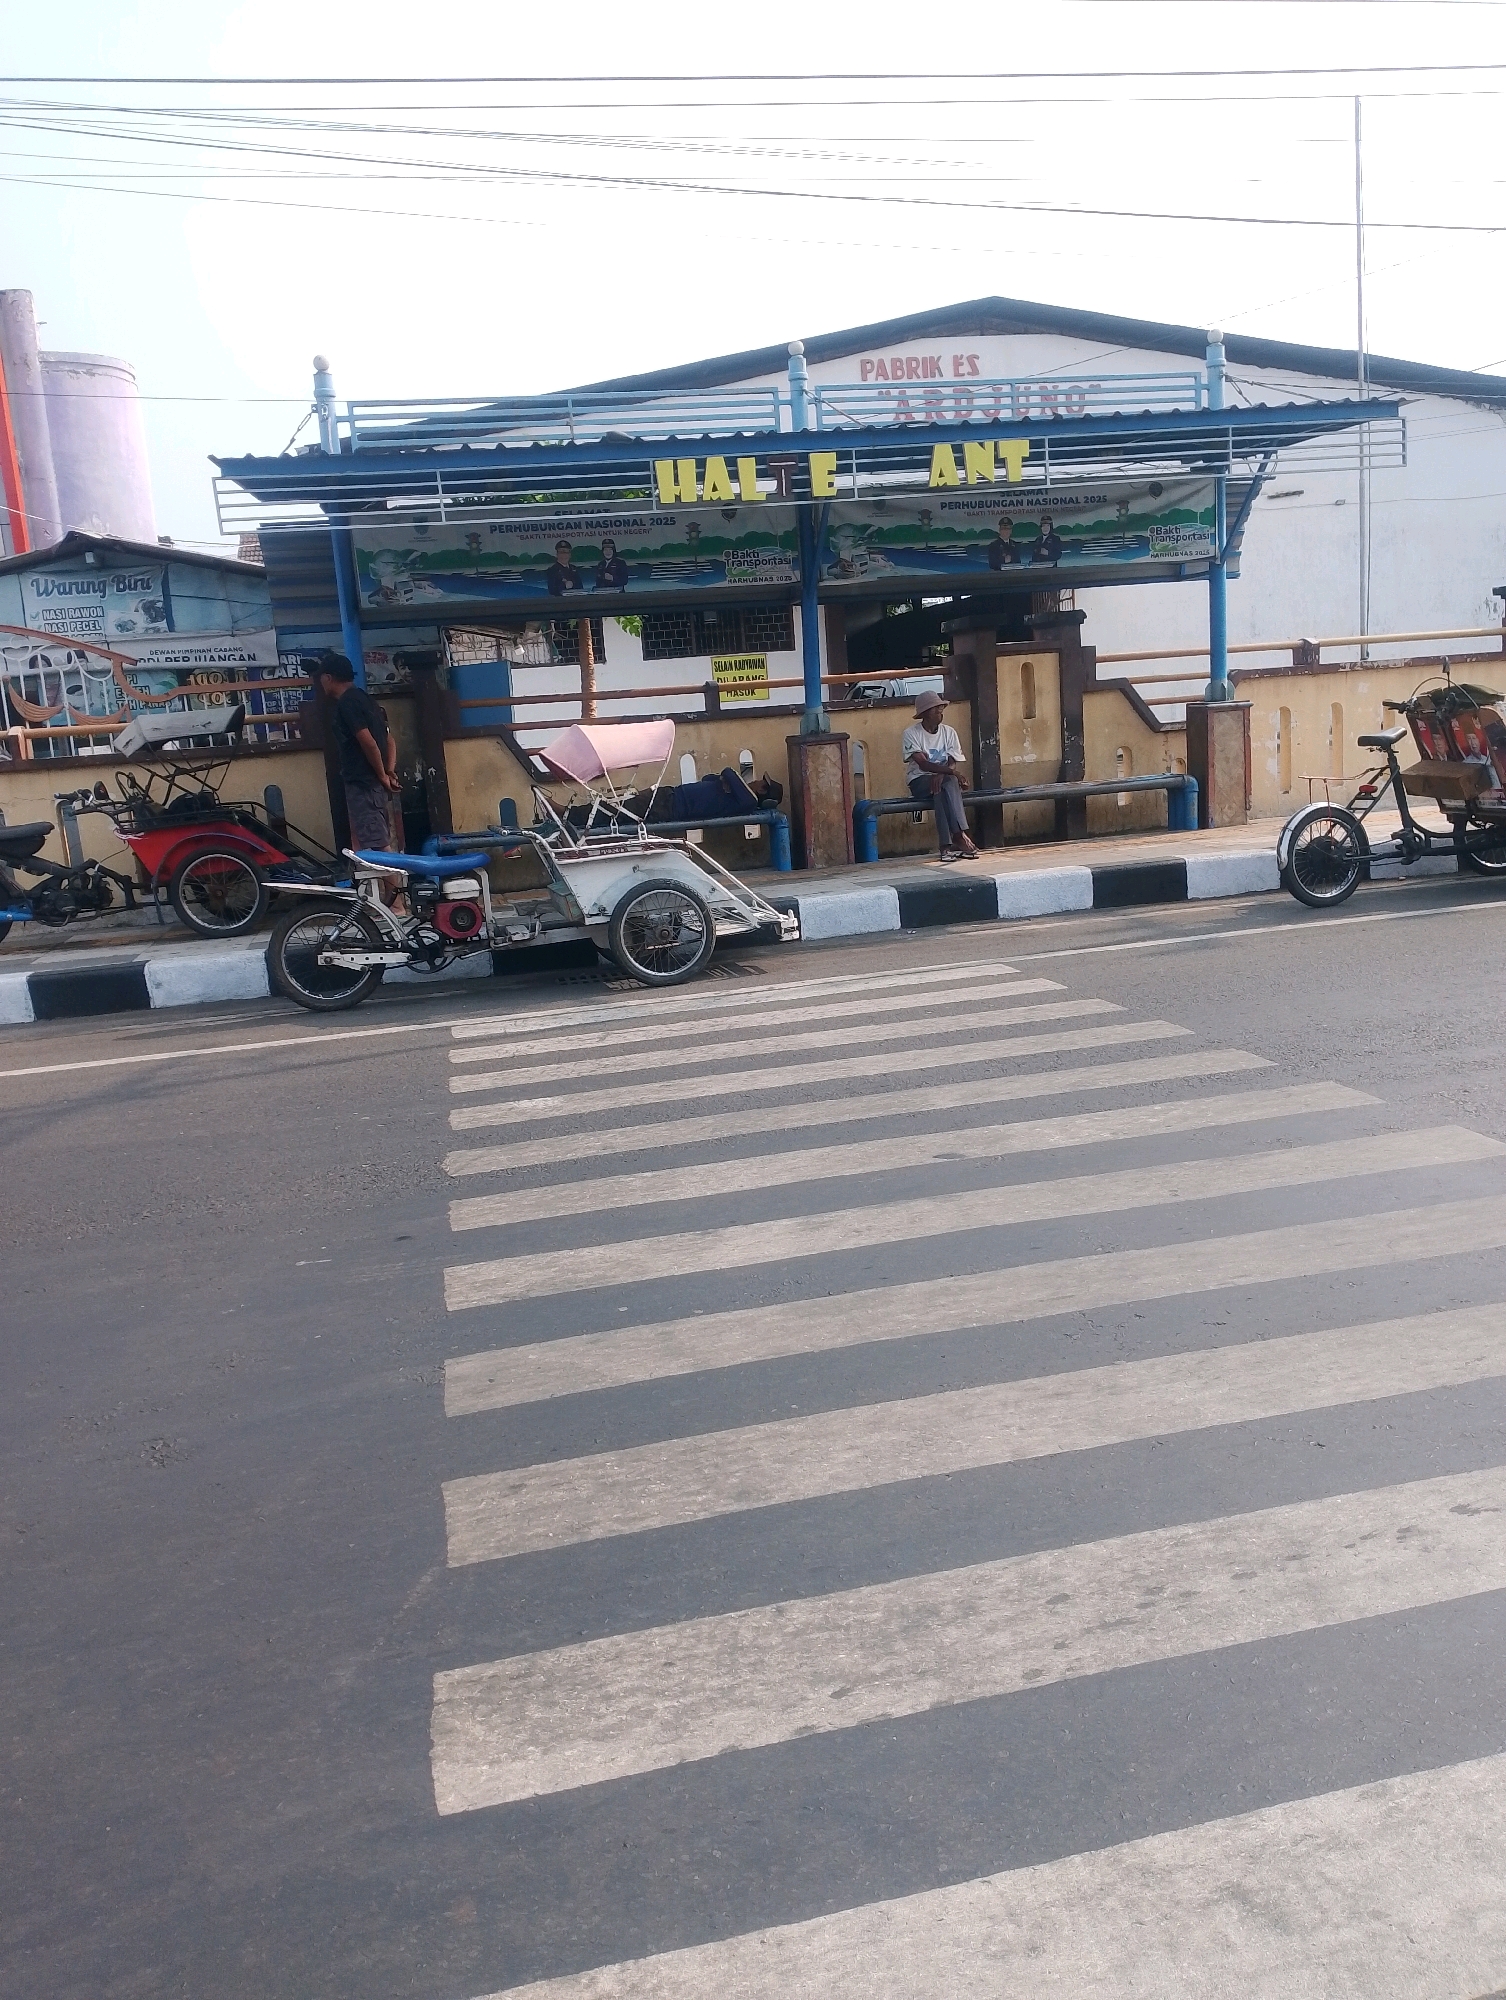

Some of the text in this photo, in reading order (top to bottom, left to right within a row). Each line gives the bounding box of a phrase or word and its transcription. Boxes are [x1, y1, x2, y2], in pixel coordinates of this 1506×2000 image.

[860, 355, 943, 382] PABRIK
[929, 439, 1030, 488] ANT
[1000, 488, 1049, 497] SELAMAT
[940, 495, 1108, 510] PERHUBUNGAN NASIONAL 2025
[987, 507, 1036, 516] TRANSPORTASI
[489, 516, 677, 534] PERHUBUNGAN NASIONAL 2025
[1155, 525, 1181, 536] Bakti
[542, 531, 597, 539] TRANSPORTASI
[1149, 530, 1210, 544] Transportasi
[732, 549, 760, 560] Bakti
[724, 555, 791, 569] Transportasi
[30, 574, 153, 599] Warung Biru
[42, 606, 105, 621] NASI RAWON
[44, 620, 102, 633] NASI PECEL
